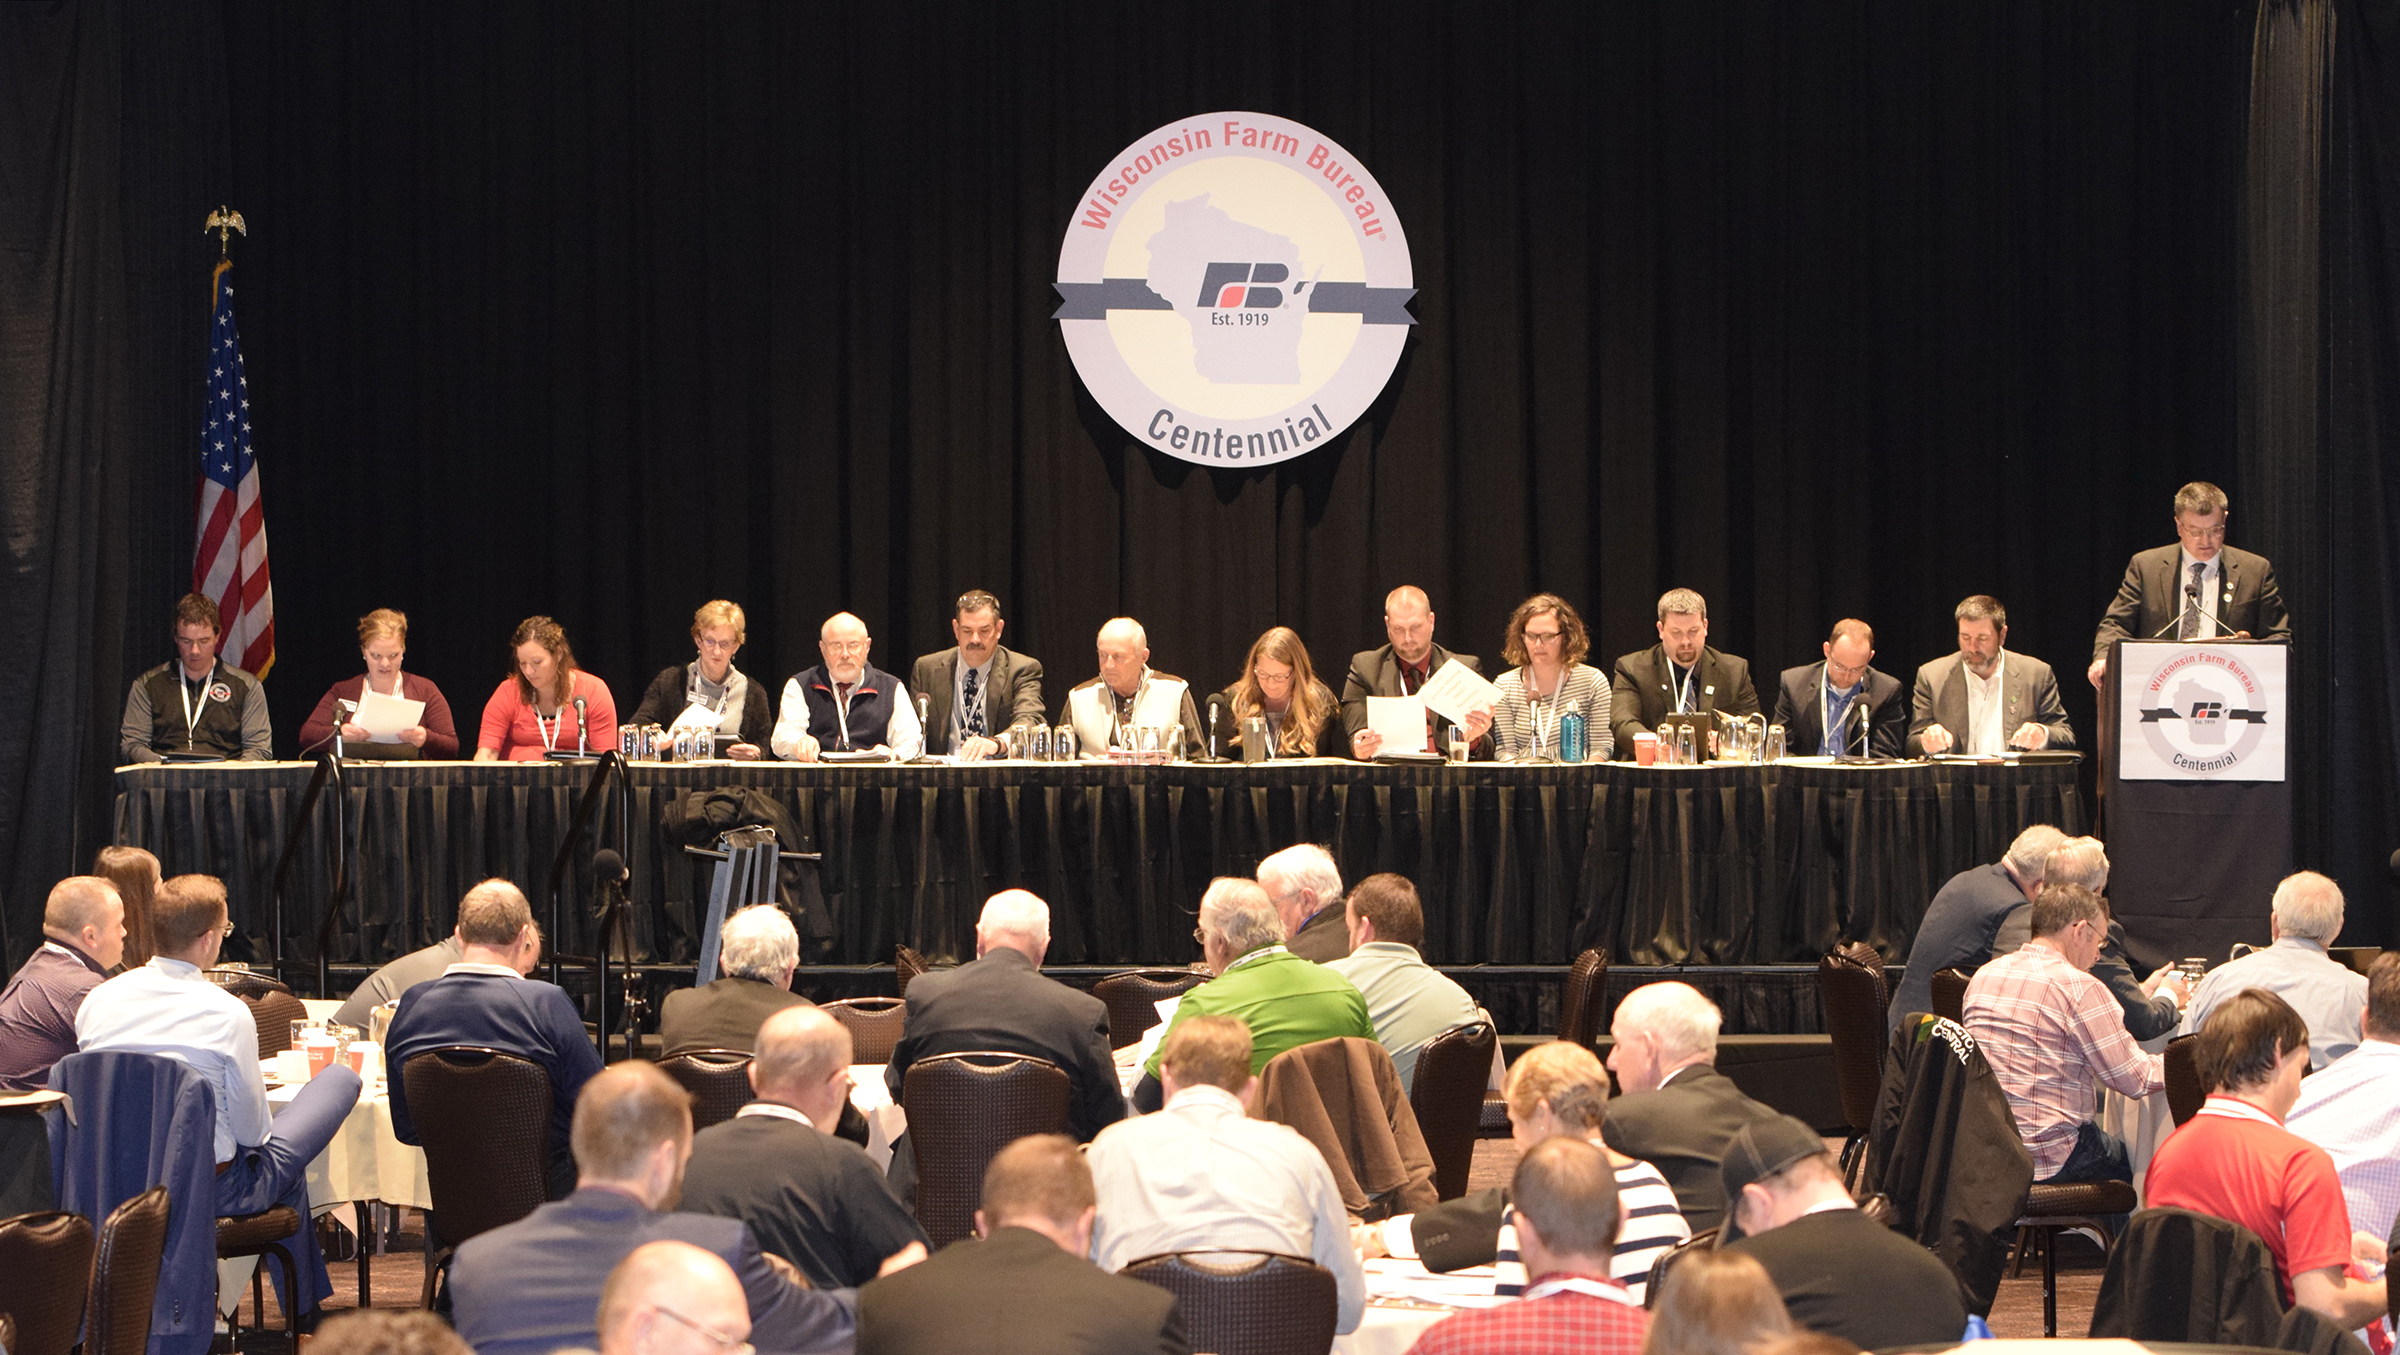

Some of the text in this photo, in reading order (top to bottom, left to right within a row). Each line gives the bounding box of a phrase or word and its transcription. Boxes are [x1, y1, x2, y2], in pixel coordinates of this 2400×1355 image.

[1081, 121, 1384, 237] Wisconsin Farm Bureau
[1211, 312, 1269, 327] Est. 1919
[1148, 403, 1333, 460] Centennial
[2150, 653, 2255, 694] Wisconsin Farm Bureau
[2173, 752, 2238, 771] Centennial
[1931, 1023, 1970, 1066] CENTRAL
[1938, 1016, 1975, 1053] TRACTO
